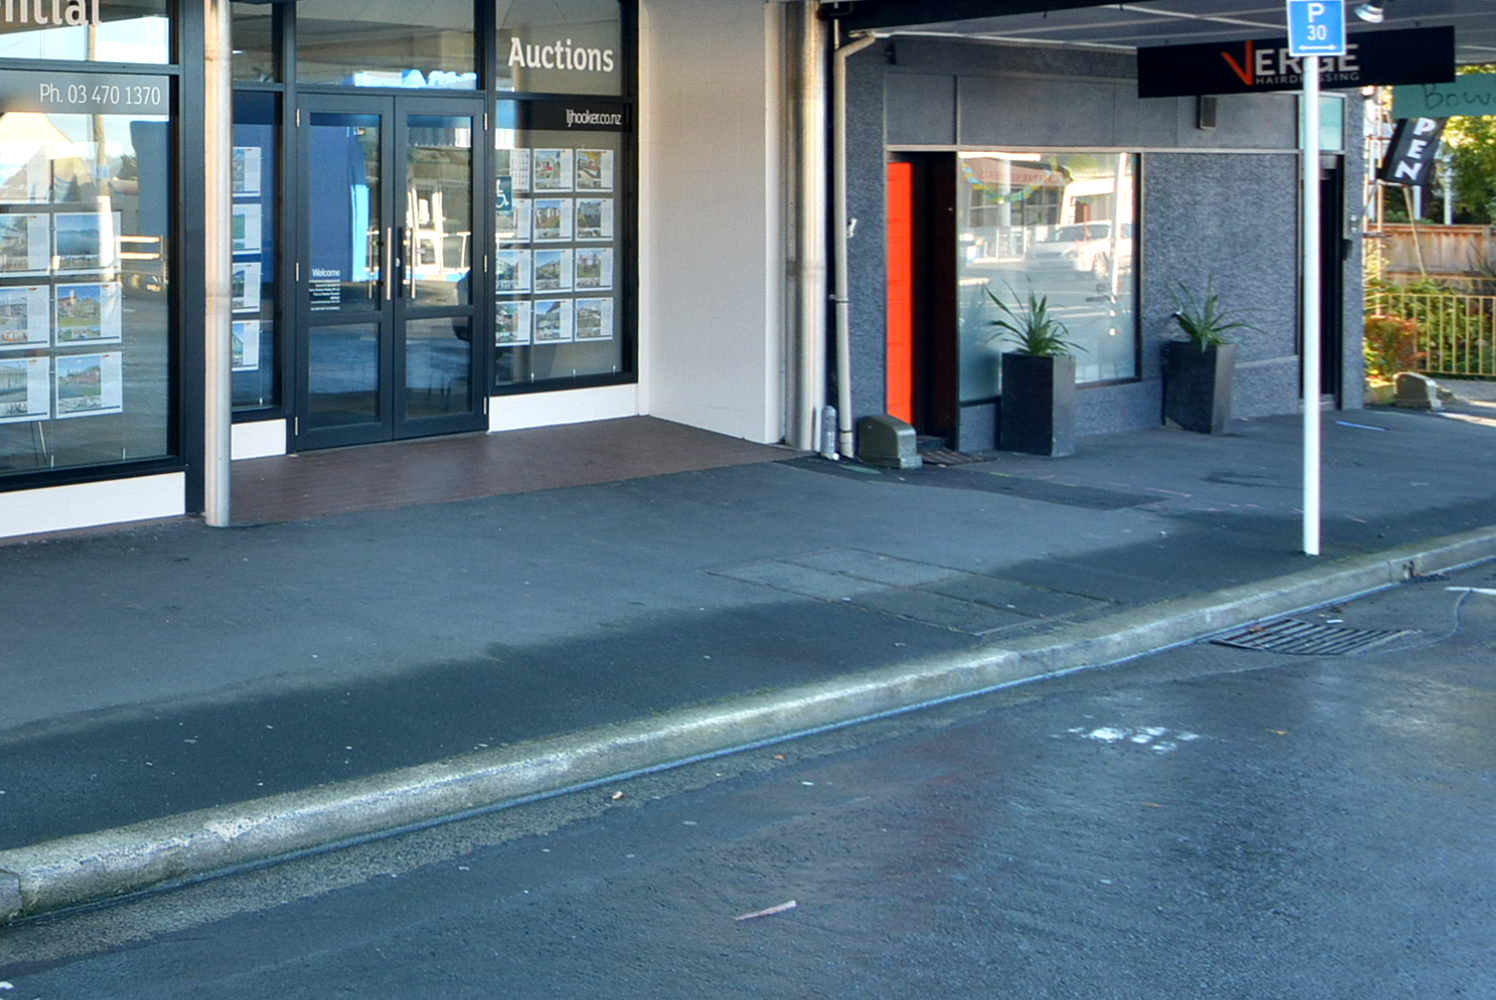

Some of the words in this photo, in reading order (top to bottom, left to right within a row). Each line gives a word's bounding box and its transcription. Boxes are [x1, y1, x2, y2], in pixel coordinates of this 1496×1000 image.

[1307, 2, 1325, 23] P
[1307, 25, 1328, 42] 30
[508, 36, 615, 72] Auctions
[1255, 71, 1361, 86] HAIRDSSING
[39, 82, 64, 103] Ph.
[67, 84, 87, 104] 03
[91, 85, 120, 105] 470
[125, 85, 161, 106] 1370
[565, 108, 622, 128] ljhooker.co.nz
[1393, 116, 1437, 181] PEN
[312, 268, 341, 278] Welcome
